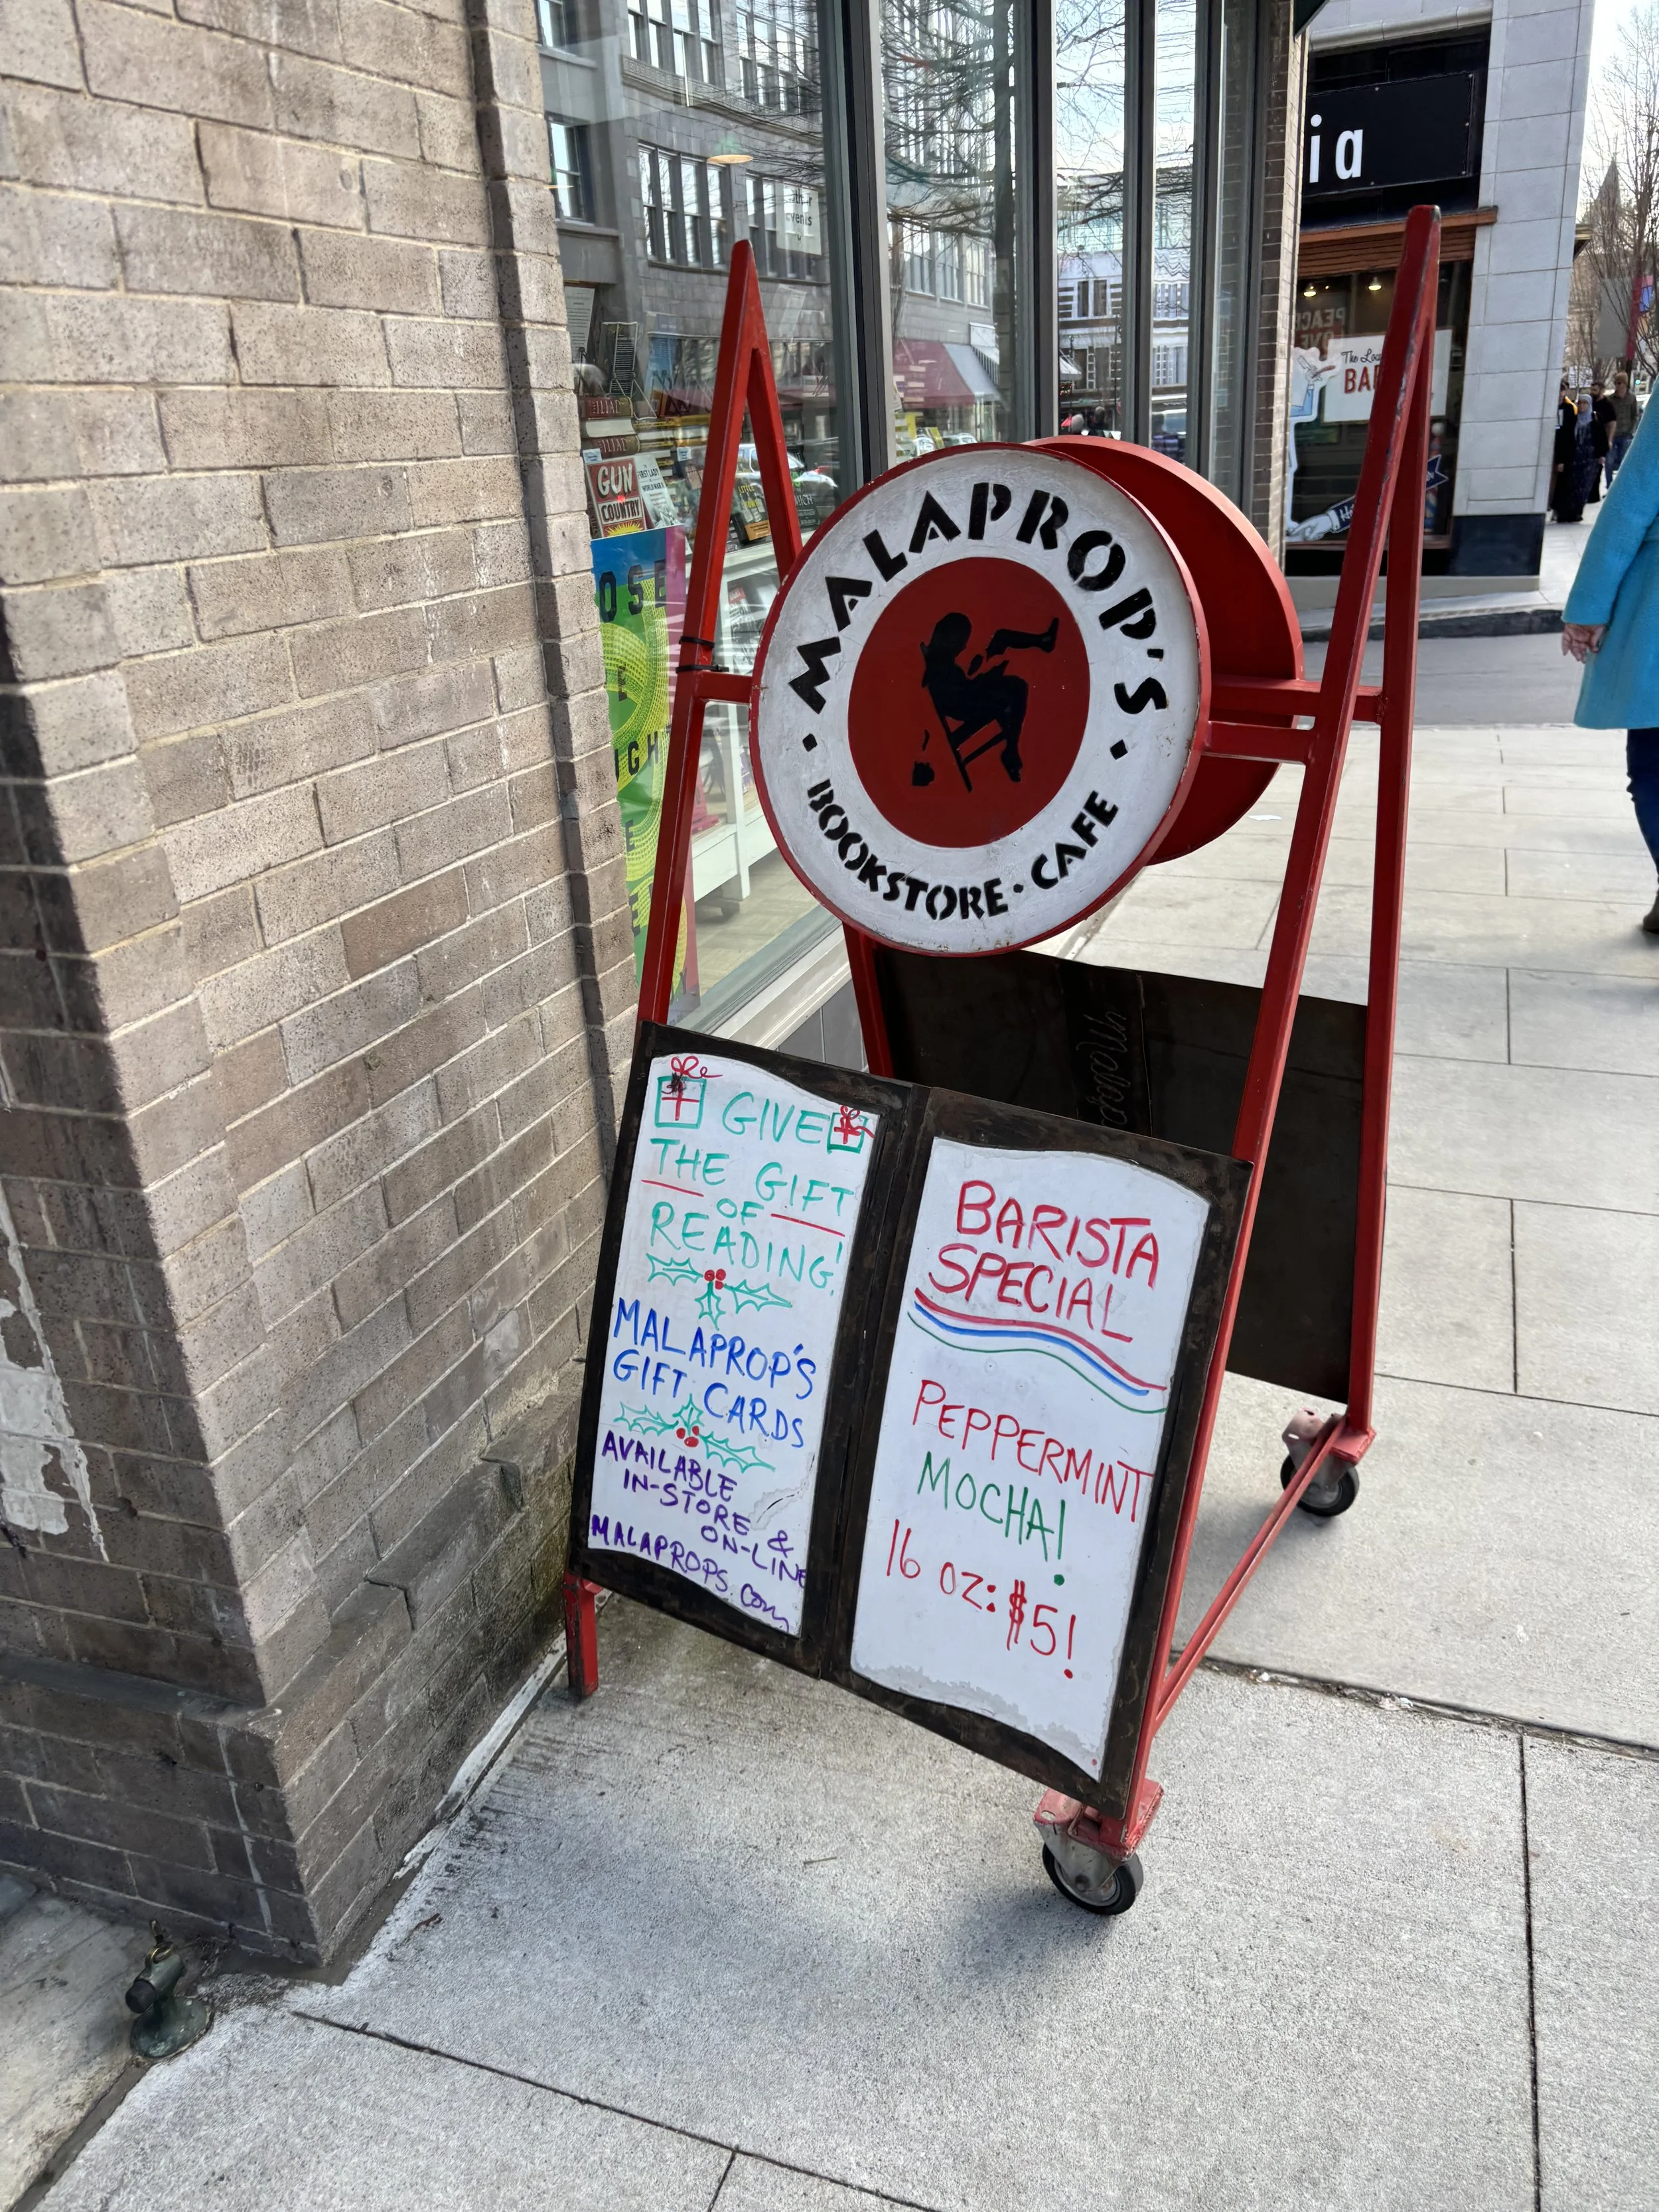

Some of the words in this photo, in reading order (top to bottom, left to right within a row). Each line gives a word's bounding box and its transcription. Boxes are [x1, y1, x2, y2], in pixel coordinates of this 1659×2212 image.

[1309, 114, 1363, 183] ia
[786, 212, 813, 226] vents
[1340, 350, 1359, 364] The
[595, 400, 621, 414] ILIAD
[602, 437, 628, 453] ILIAD
[597, 463, 633, 499] GUN
[601, 498, 640, 523] COUNTRY
[788, 482, 1168, 715] MALAPROP'S
[808, 780, 1008, 921] BOOKSTORE
[1031, 790, 1118, 890] CAFE
[1075, 1011, 1131, 1128] Malap
[722, 1092, 830, 1144] GIVE
[650, 1138, 729, 1185] THE
[755, 1162, 855, 1217] GIFT
[716, 1198, 765, 1226] OF
[650, 1201, 843, 1297] READING!
[956, 1180, 1159, 1290] BARISTA
[928, 1243, 1133, 1343] SPECIAL
[613, 1297, 817, 1400] MALAPROP'S
[613, 1349, 688, 1398] GIFT
[703, 1382, 805, 1448] CARDS
[601, 1430, 738, 1502] AVAILABLE
[912, 1379, 1155, 1522] PEPPERMINT
[623, 1468, 751, 1536] IN-STORE
[767, 1530, 794, 1559] &
[916, 1451, 1066, 1586] MOCHA!
[701, 1525, 806, 1589] ON-LINE
[887, 1518, 921, 1578] 16
[1007, 1580, 1076, 1679] $5!
